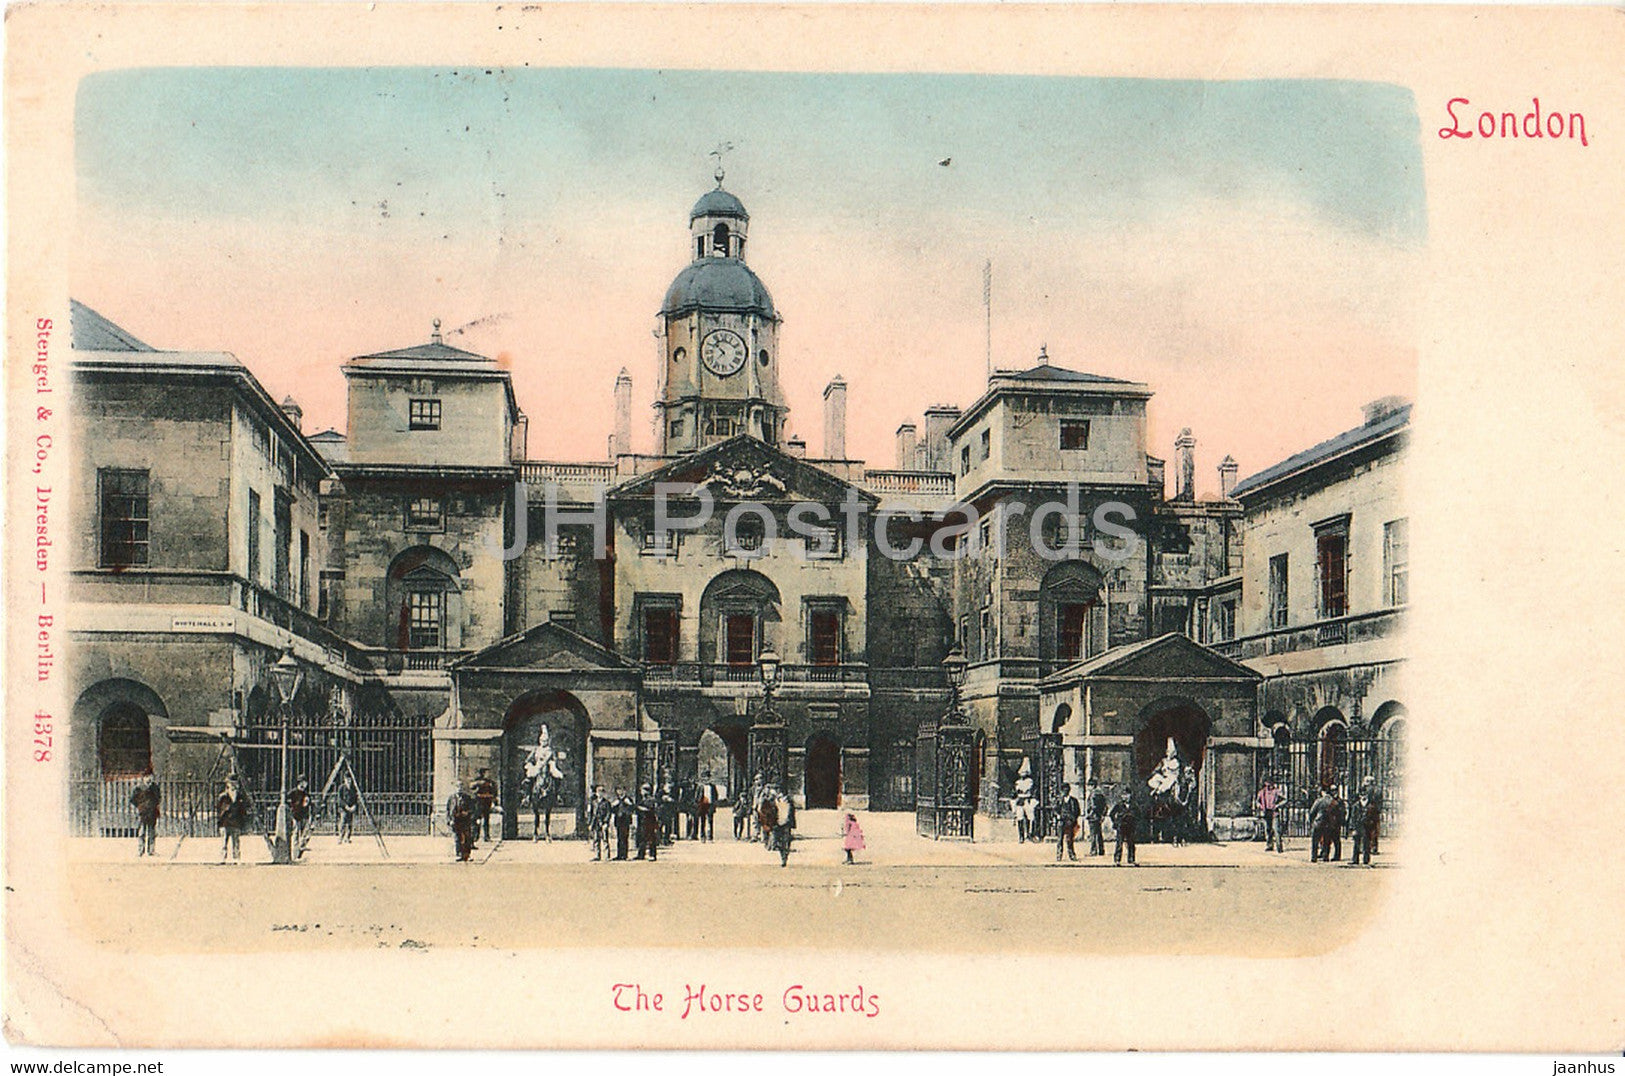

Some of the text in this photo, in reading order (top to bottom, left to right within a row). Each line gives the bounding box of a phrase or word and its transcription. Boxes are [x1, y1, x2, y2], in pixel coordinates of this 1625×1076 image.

[1438, 97, 1589, 147] London
[33, 317, 53, 394] Stengel
[36, 406, 53, 421] &
[32, 434, 53, 474] Co.,
[36, 487, 53, 573] Dresden
[37, 614, 54, 682] Berlin
[33, 711, 53, 763] 4378
[611, 983, 880, 1020] The Horse Guards
